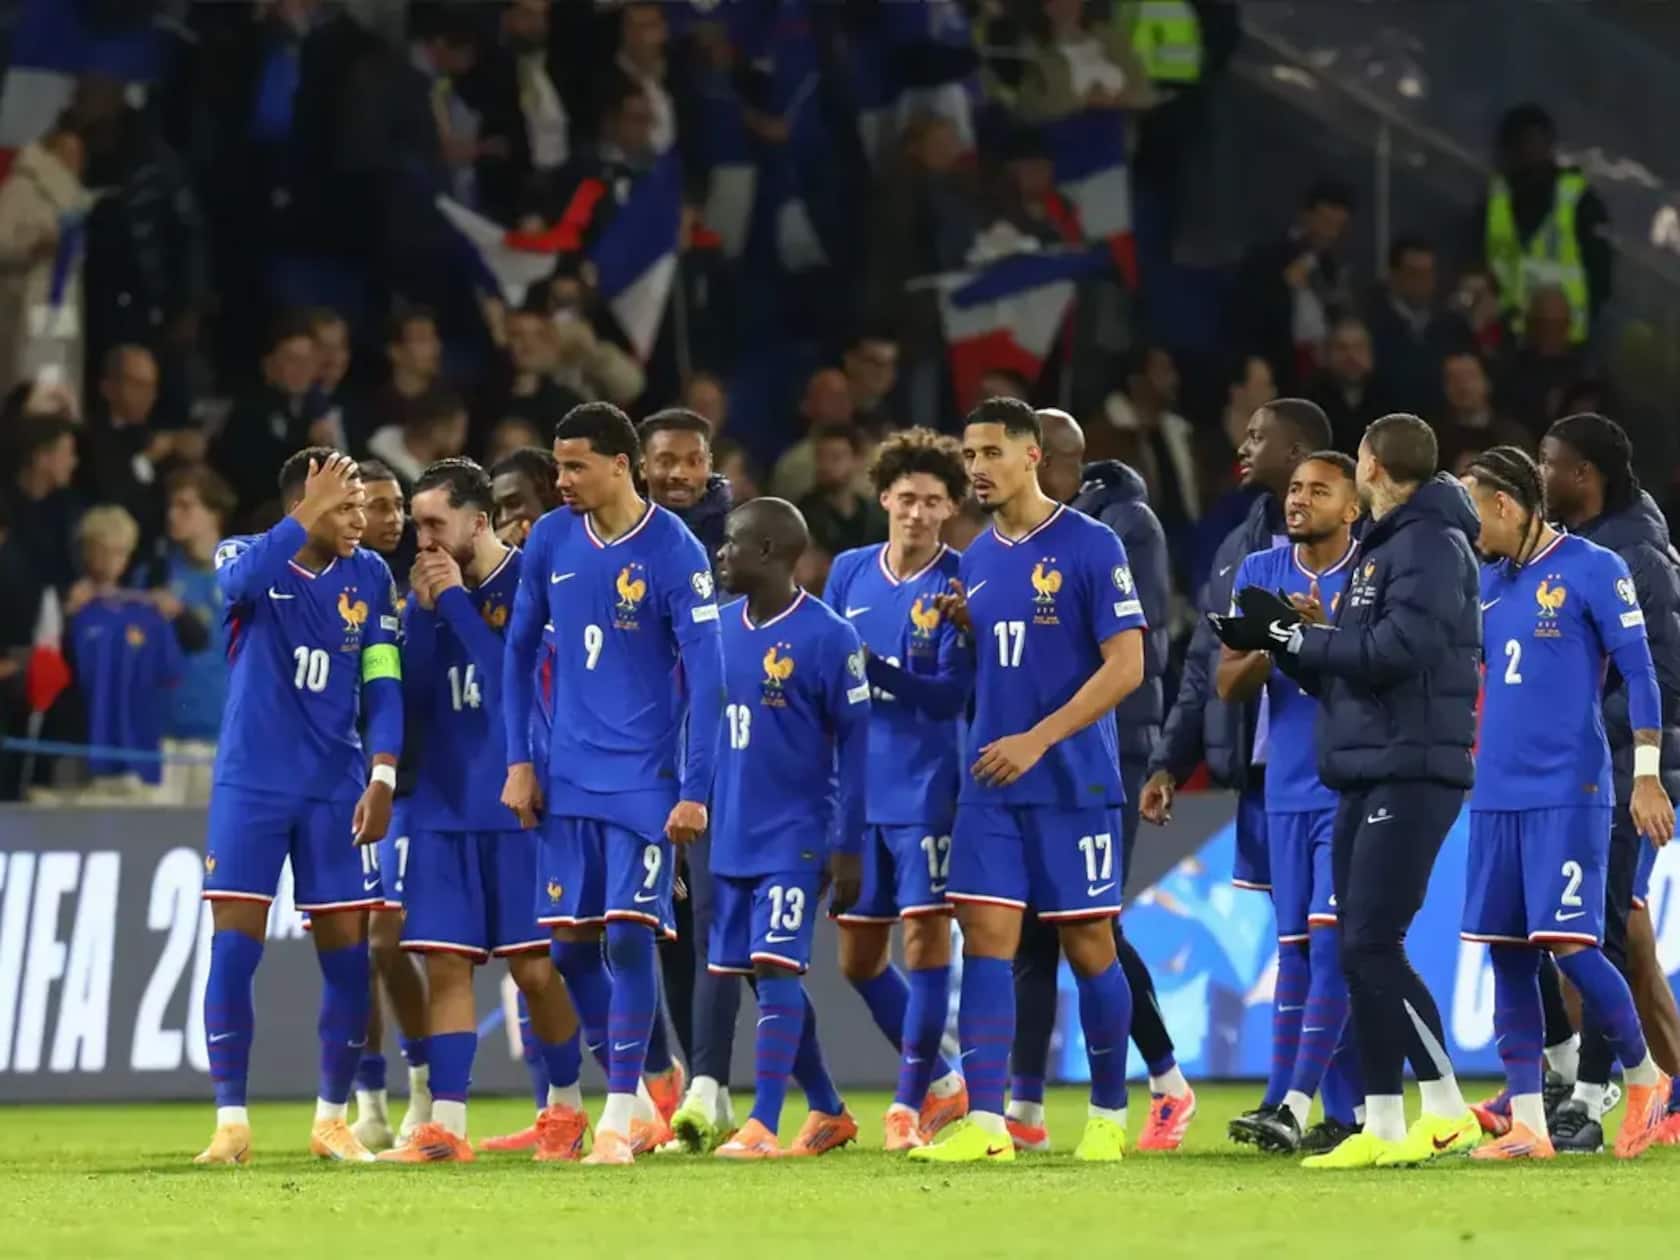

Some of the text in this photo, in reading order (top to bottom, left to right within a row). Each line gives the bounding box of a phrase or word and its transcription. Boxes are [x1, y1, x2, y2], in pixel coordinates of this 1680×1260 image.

[584, 624, 604, 670] 9
[993, 621, 1026, 667] 17
[1504, 639, 1523, 684] 2
[294, 645, 330, 692] 10
[448, 663, 482, 711] 14
[726, 703, 751, 749] 13
[643, 844, 662, 889] 9
[1078, 832, 1113, 881] 17
[1561, 860, 1583, 906] 2
[768, 885, 805, 931] 13
[0, 850, 121, 1073] IFA
